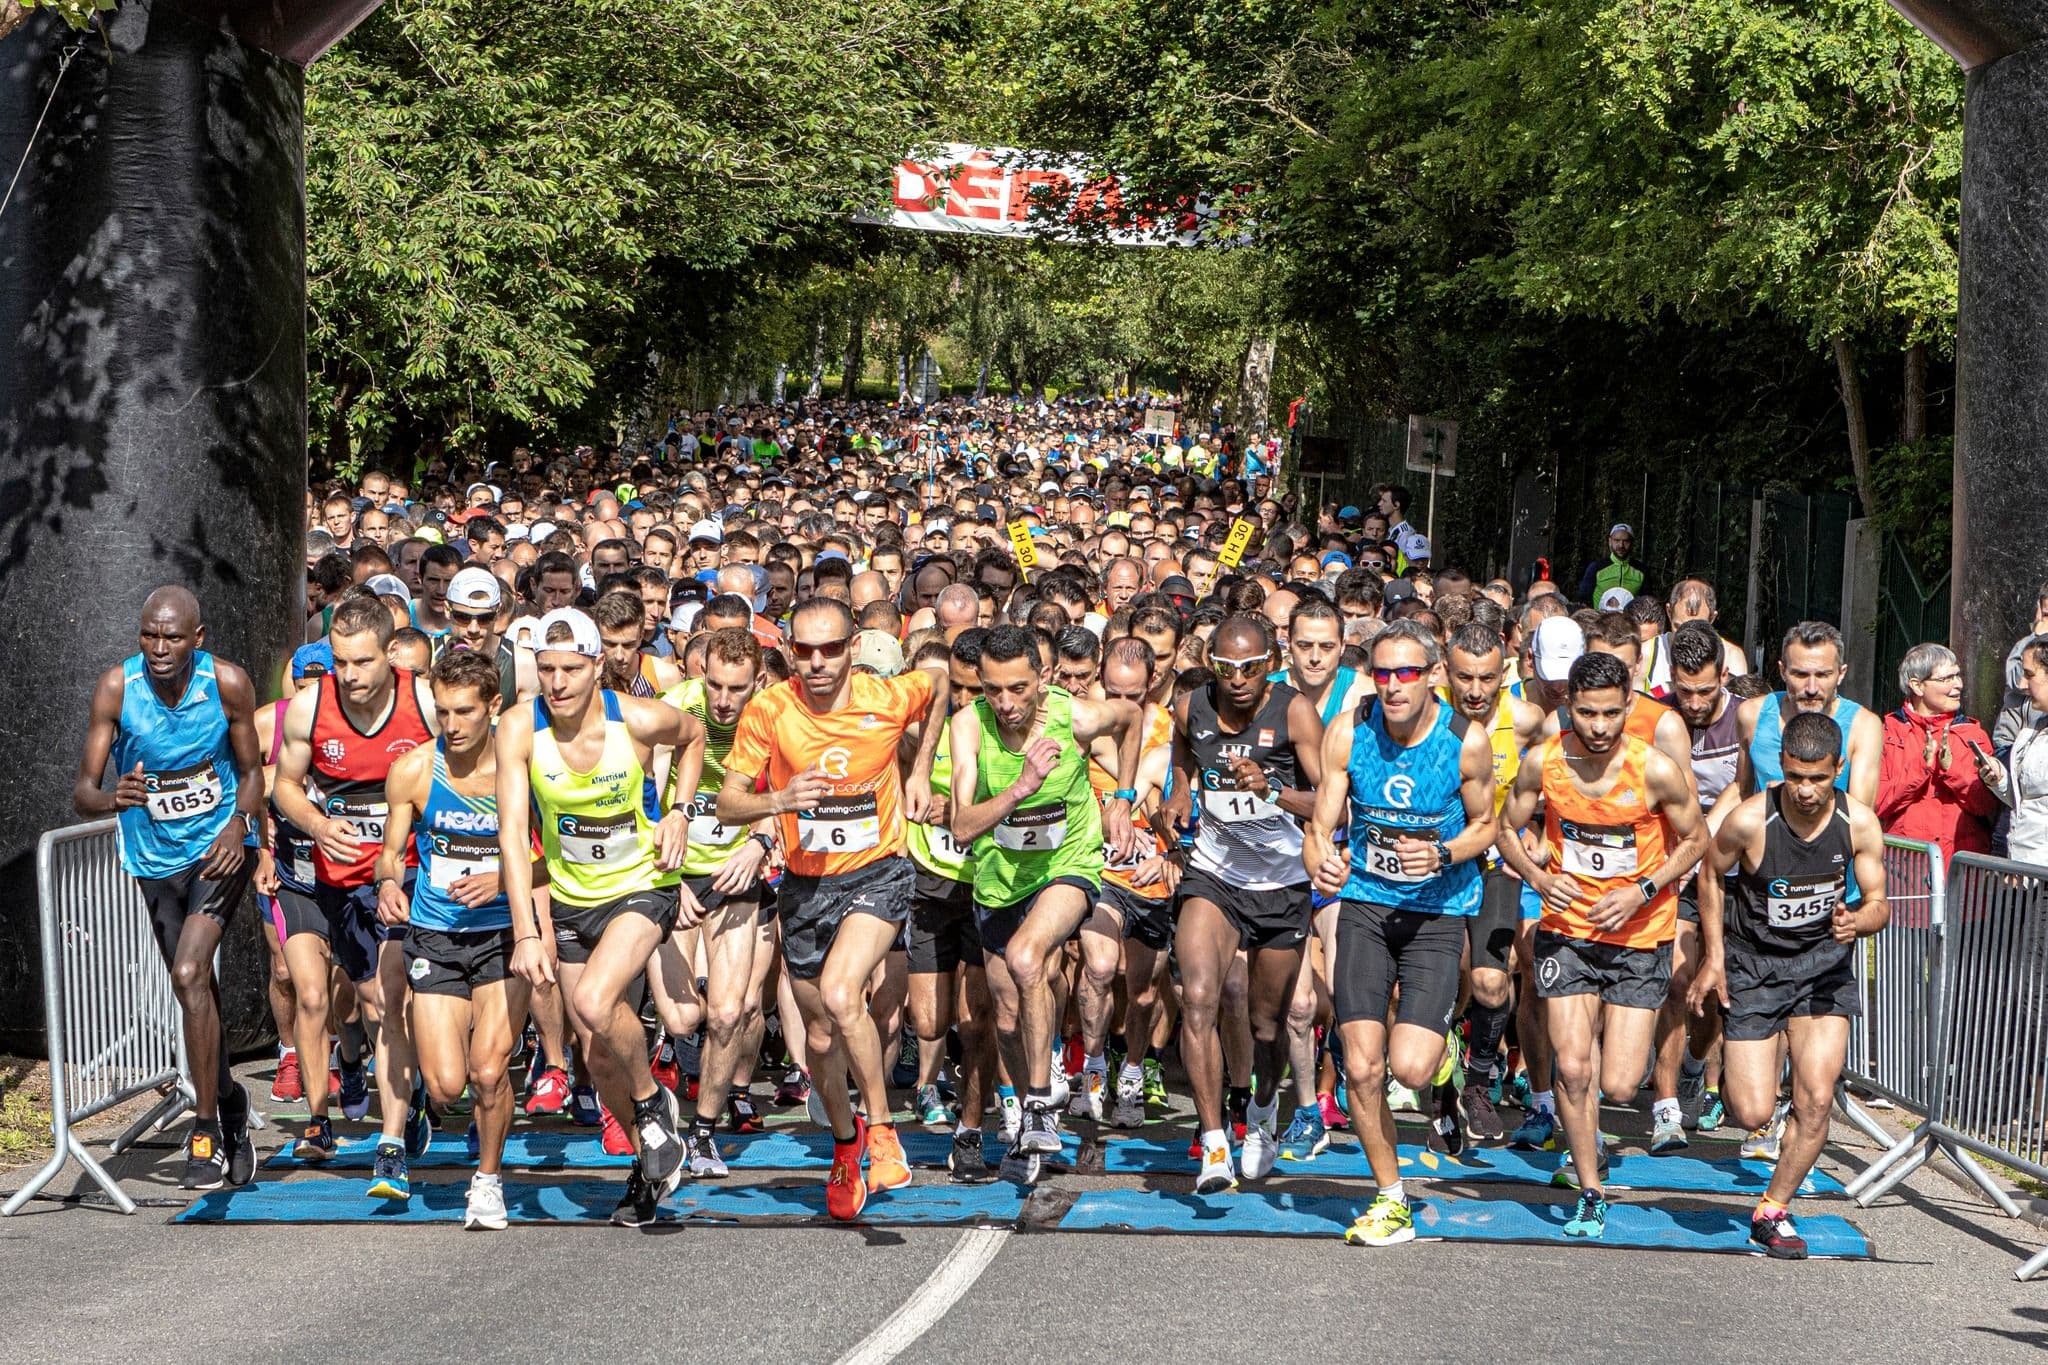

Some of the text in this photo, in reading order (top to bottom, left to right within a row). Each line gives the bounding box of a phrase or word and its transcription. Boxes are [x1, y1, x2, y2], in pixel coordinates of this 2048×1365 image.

[1015, 533, 1026, 542] H
[1227, 542, 1240, 553] H
[1234, 524, 1248, 541] 30
[1020, 546, 1033, 563] 30
[157, 787, 215, 815] 1653
[819, 800, 876, 815] runningconseil
[1229, 797, 1256, 815] 11
[711, 822, 724, 838] 4
[831, 827, 846, 846] 6
[1023, 831, 1037, 845] 2
[592, 844, 606, 859] 8
[1592, 853, 1605, 871] 9
[1778, 895, 1835, 921] 3455
